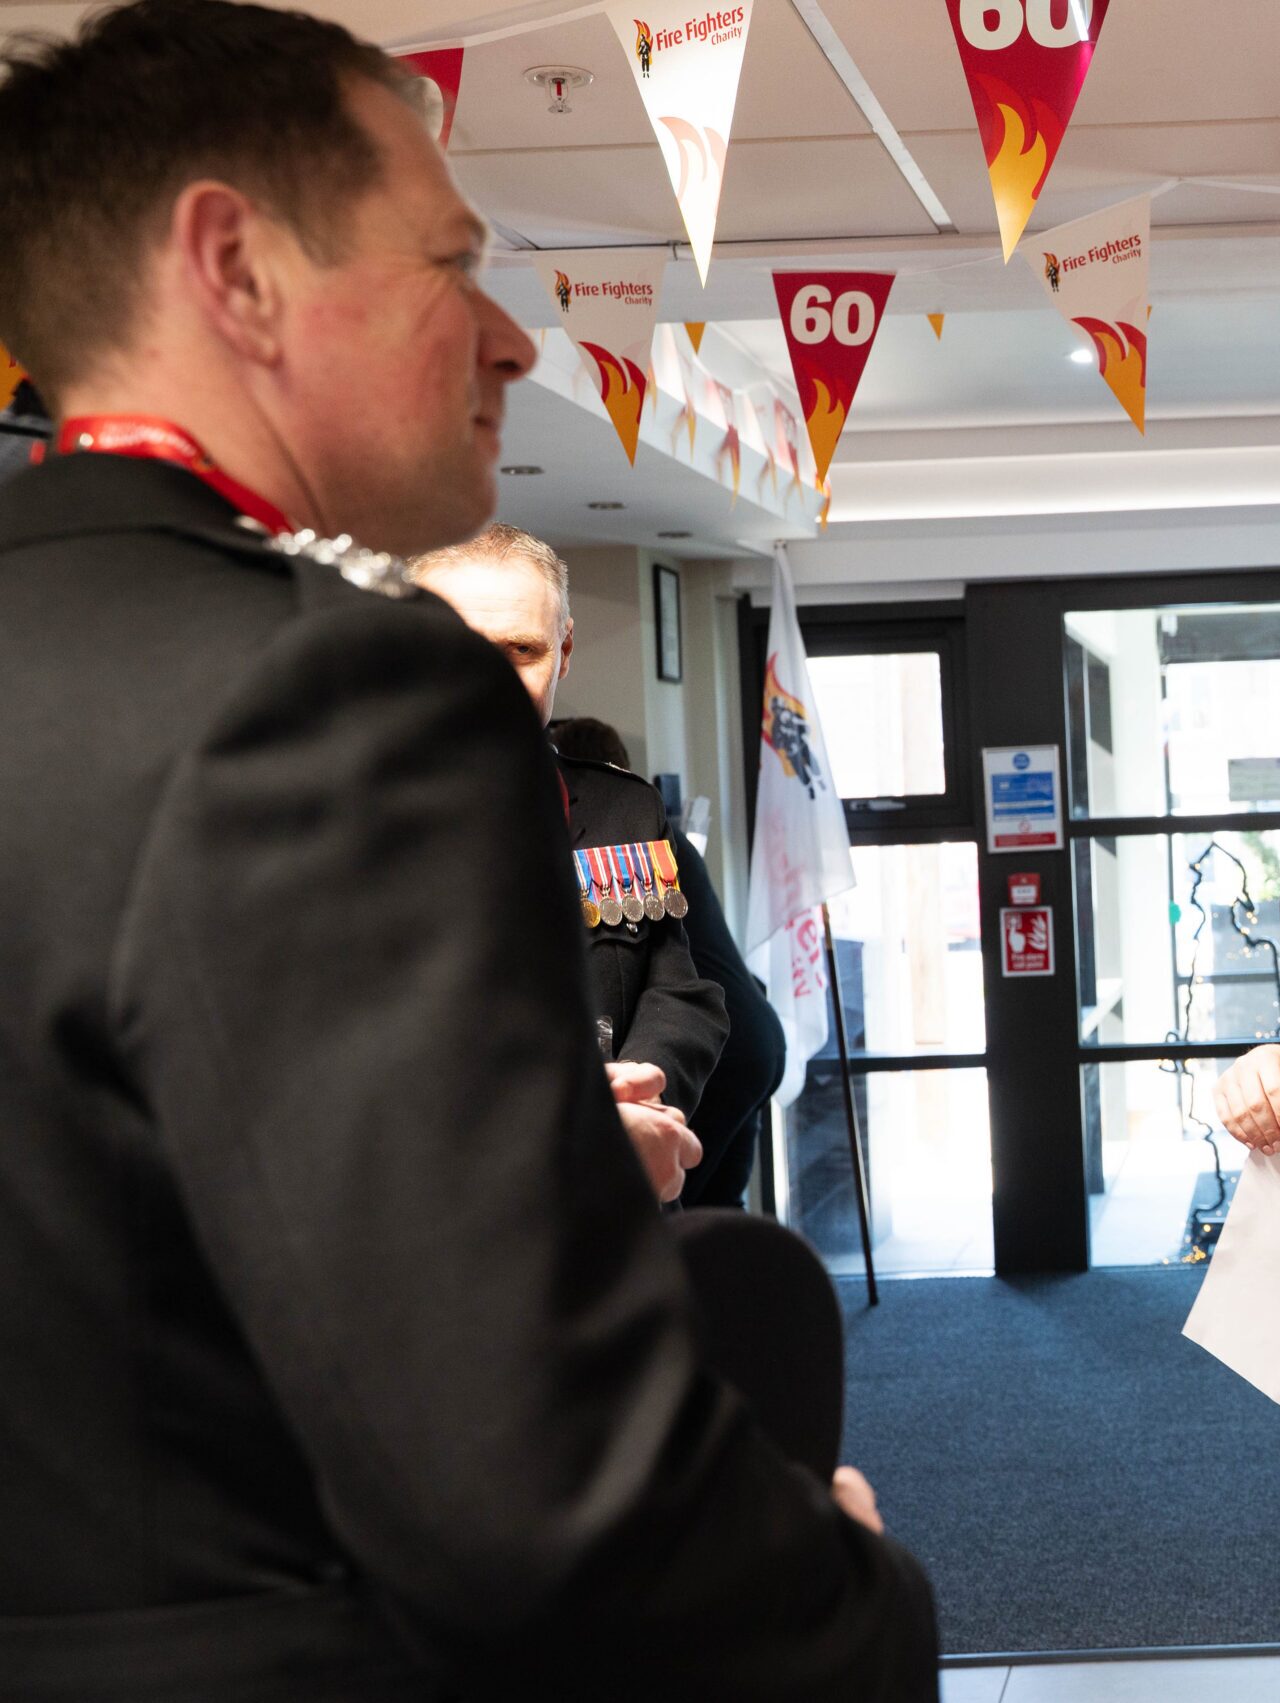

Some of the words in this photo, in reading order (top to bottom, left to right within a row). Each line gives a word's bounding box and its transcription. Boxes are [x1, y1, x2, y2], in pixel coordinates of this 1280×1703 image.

[656, 29, 683, 51] Fire
[685, 7, 744, 41] Fighters
[711, 27, 742, 45] Charity
[960, 0, 1093, 51] 60
[1062, 256, 1087, 272] Fire
[1088, 234, 1142, 262] Fighters
[1112, 249, 1141, 264] Charity
[574, 282, 599, 297] Fire
[602, 281, 653, 299] Fighters
[625, 297, 652, 306] Charity
[790, 284, 876, 346] 60
